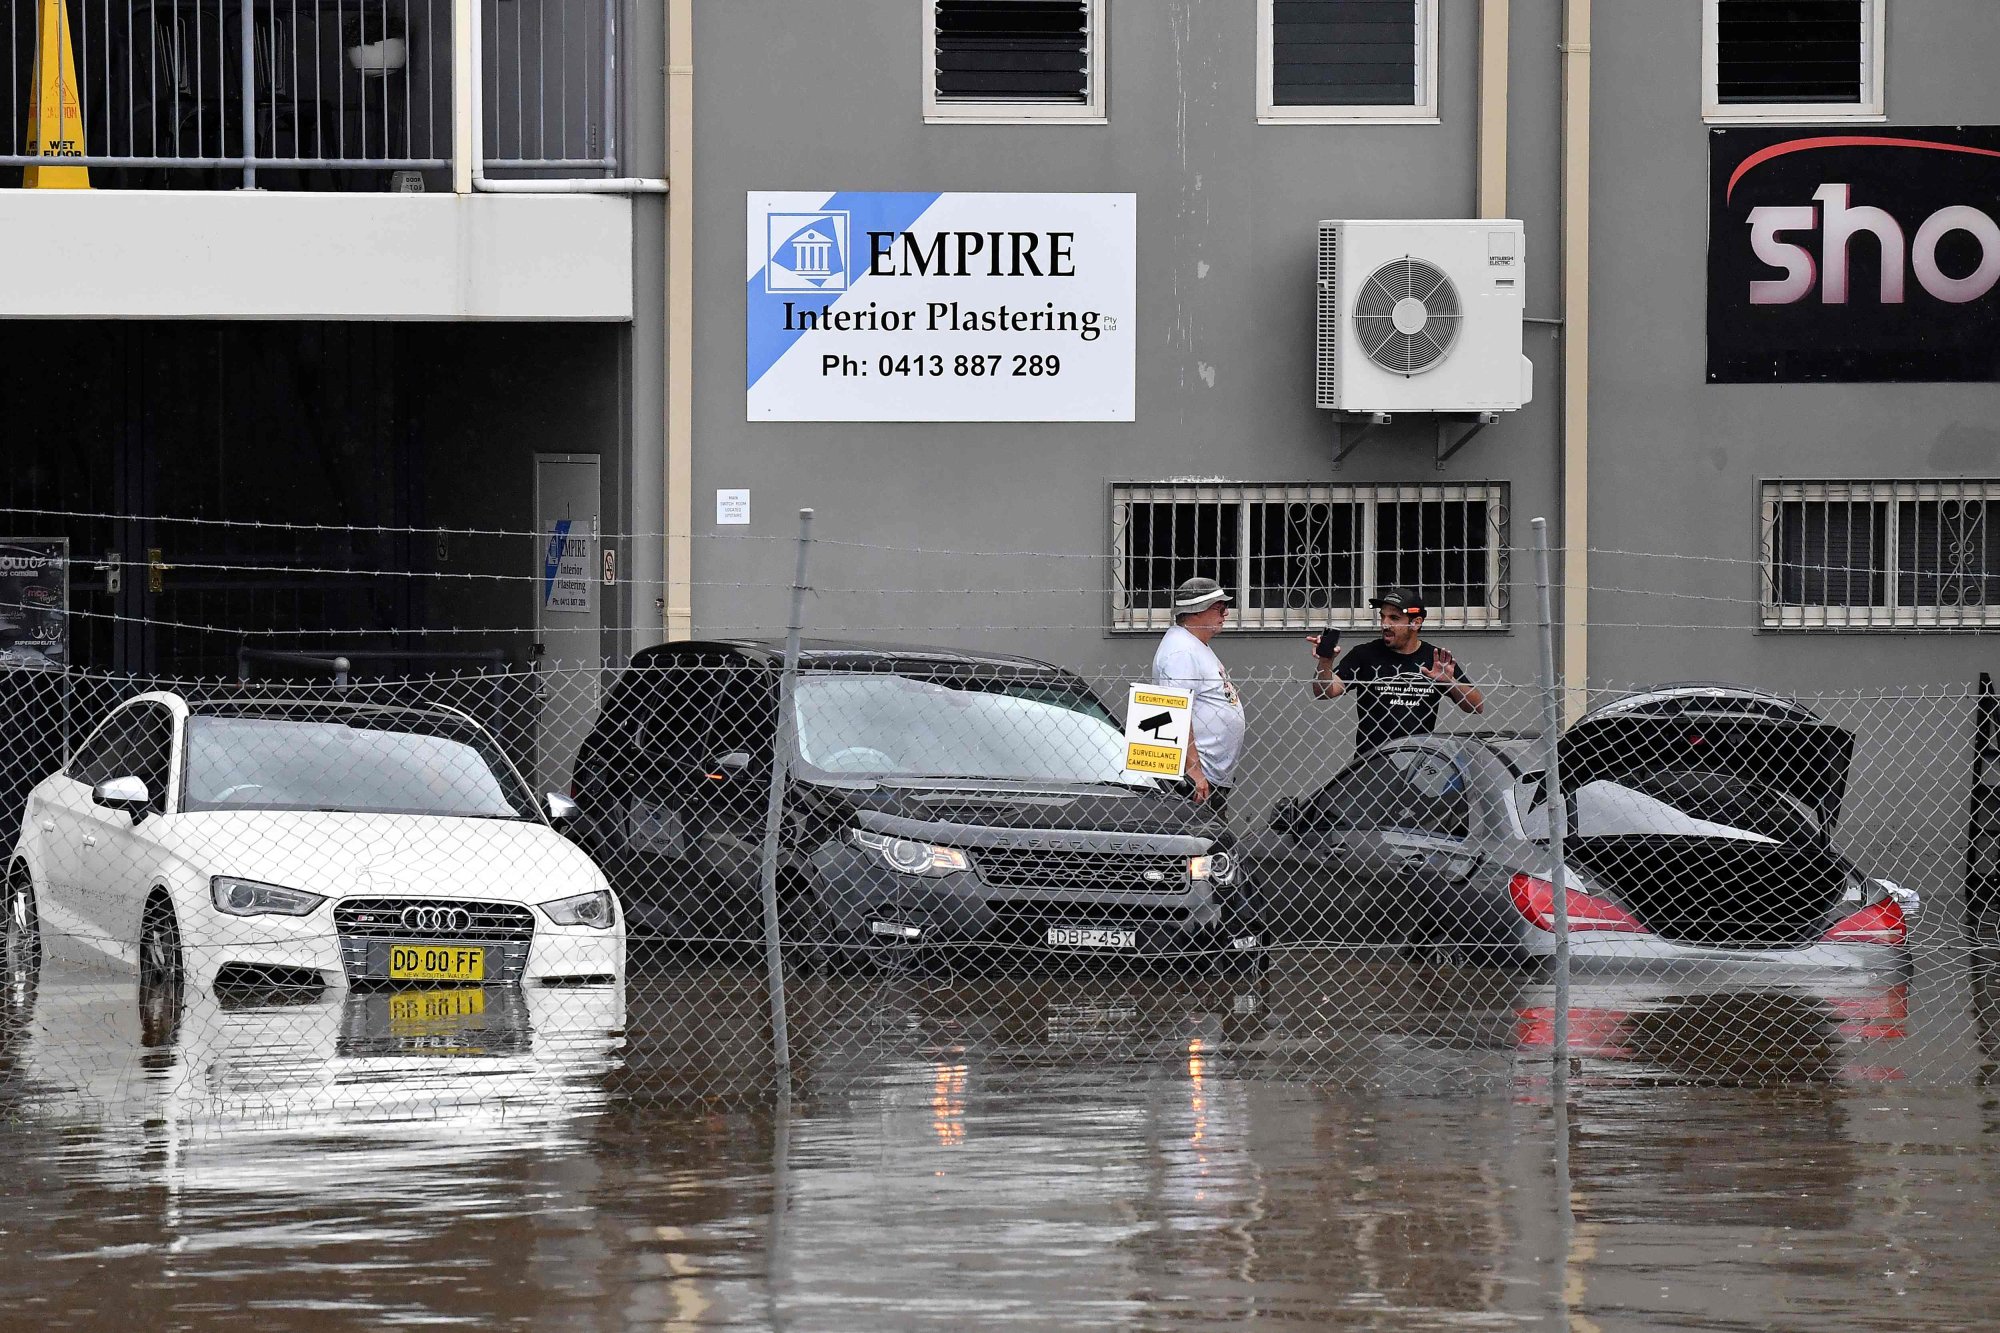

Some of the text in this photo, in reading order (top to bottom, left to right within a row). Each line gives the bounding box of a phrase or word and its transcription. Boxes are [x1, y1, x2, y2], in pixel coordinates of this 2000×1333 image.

[49, 141, 75, 149] WET
[1745, 183, 2000, 304] sho
[866, 231, 1076, 277] EMPIRE
[782, 301, 1101, 341] Interior Plastering
[1103, 316, 1117, 325] Pty
[822, 354, 1061, 377] Ph: 0413 887 289
[561, 539, 586, 557] EMPIRE
[560, 563, 583, 575] Interior
[557, 579, 587, 594] Plastering
[1138, 695, 1185, 707] SECURITY NOTICE
[1132, 748, 1177, 760] SURVEILLANCE
[1128, 758, 1157, 768] CAMERAS
[997, 838, 1158, 852] DISCOVERY
